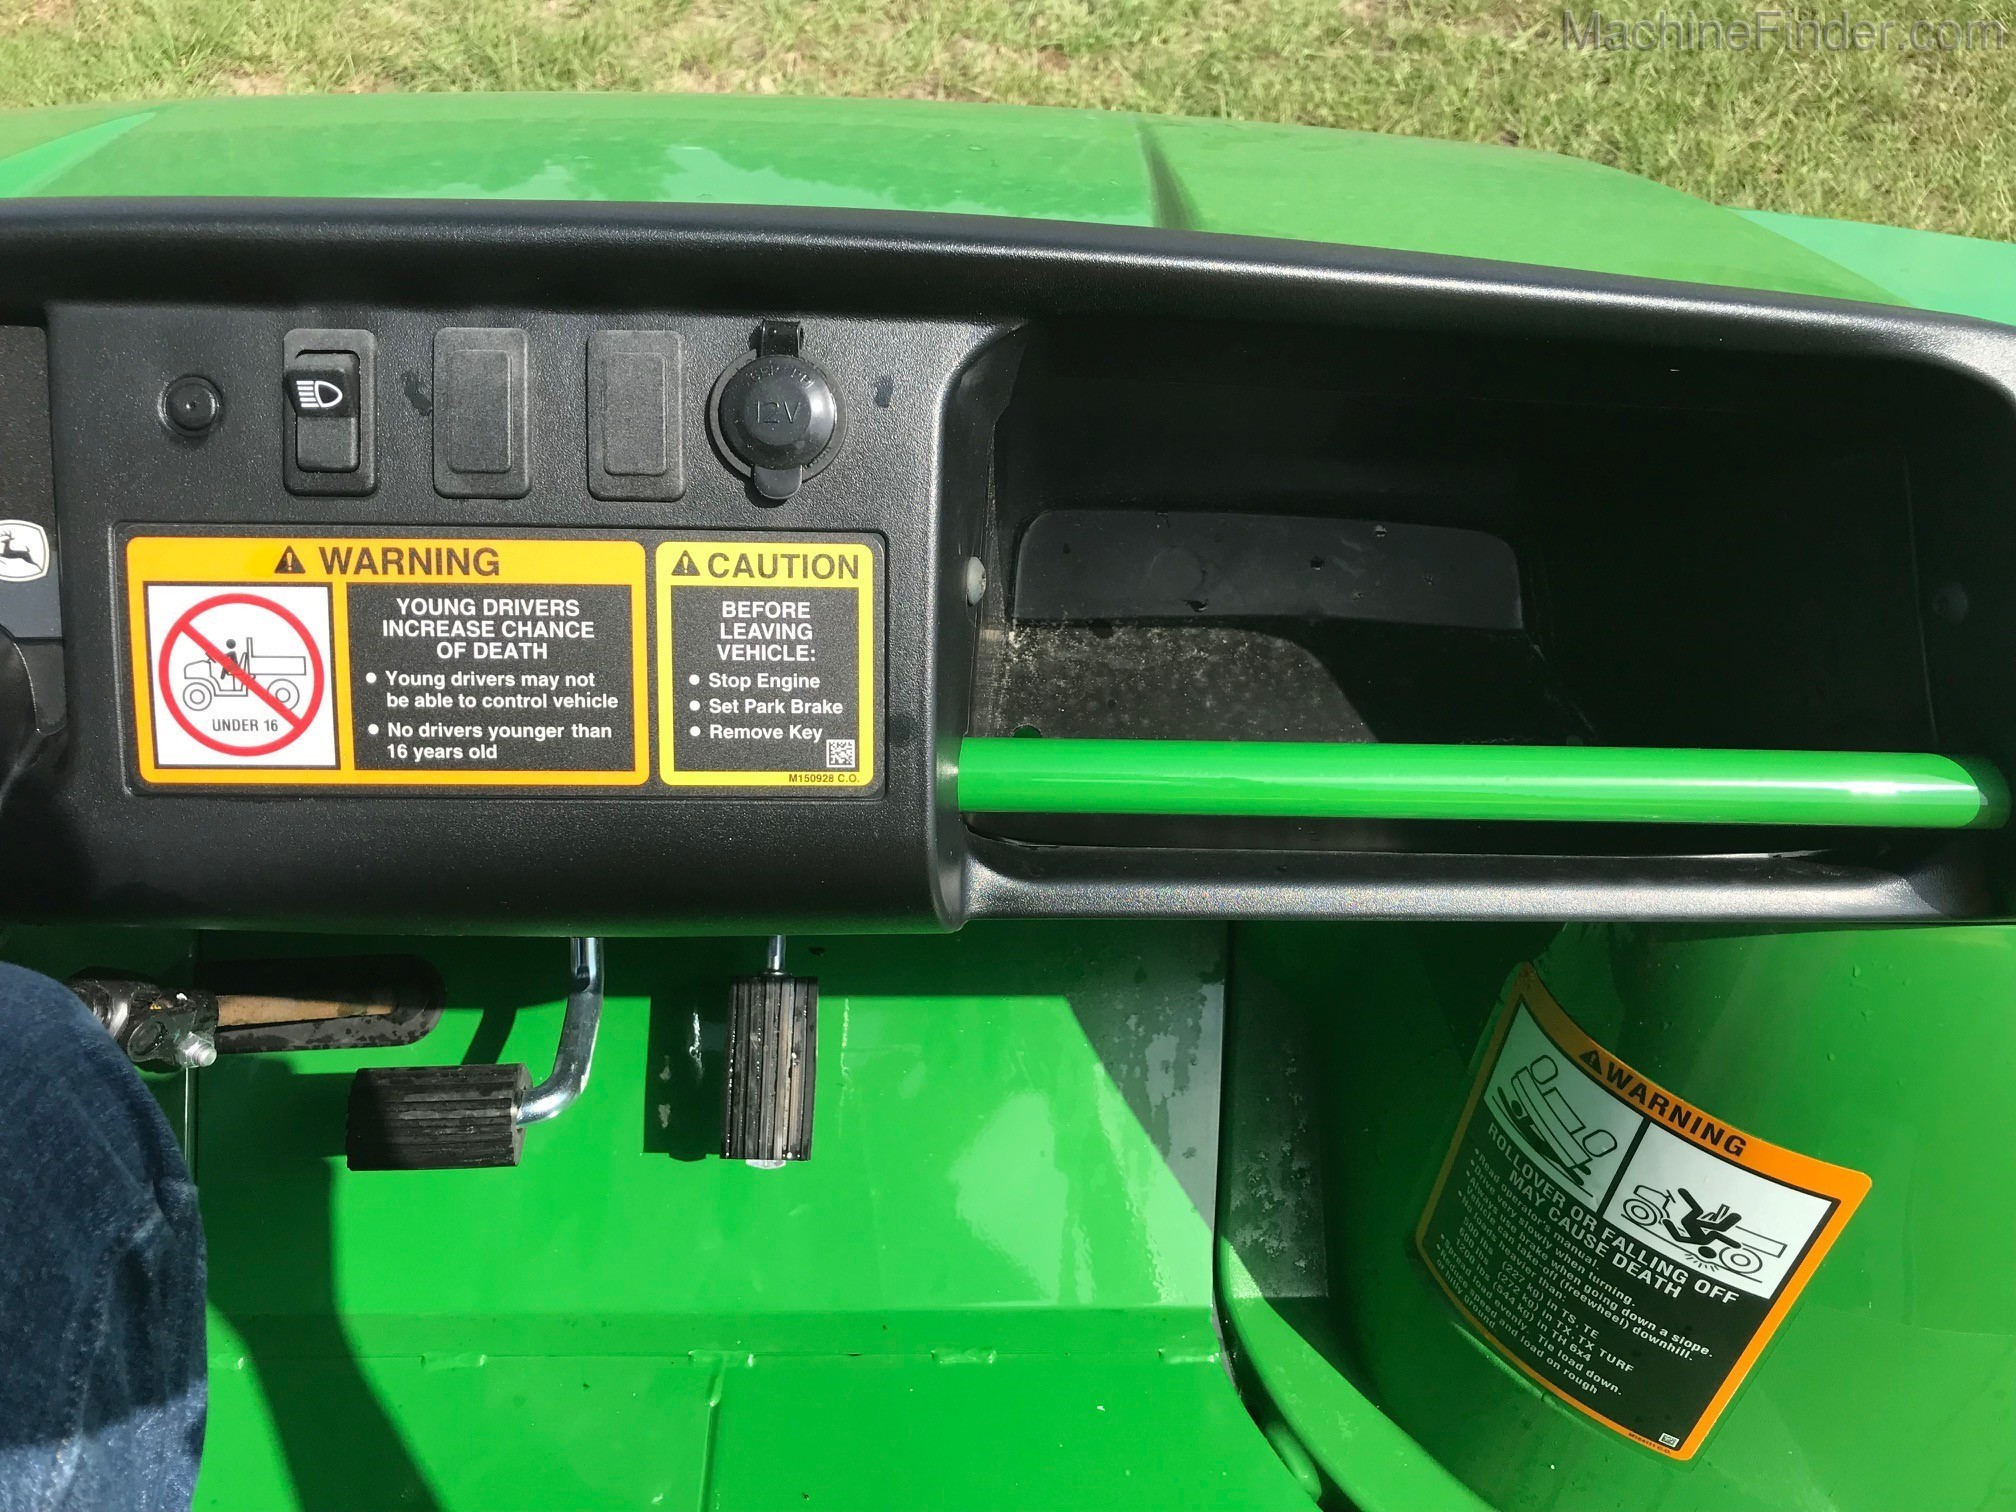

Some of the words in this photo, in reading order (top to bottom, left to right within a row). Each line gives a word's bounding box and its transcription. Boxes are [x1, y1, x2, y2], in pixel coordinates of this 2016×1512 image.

[755, 400, 801, 424] 12V
[318, 546, 499, 577] WARNING
[707, 552, 859, 580] CAUTION
[396, 597, 476, 616] YOUNG
[483, 598, 580, 617] DRIVERS
[721, 600, 811, 619] BEFORE
[382, 619, 495, 638] INCREASE
[501, 620, 595, 639] CHANCE
[720, 622, 813, 640] LEAVING
[436, 642, 467, 659] OF
[473, 642, 548, 660] DEATH
[716, 644, 816, 662] VEHICLE:
[385, 670, 446, 689] Young
[450, 671, 516, 687] drivers
[521, 675, 559, 690] may
[565, 672, 596, 687] not
[708, 672, 752, 691] Stop
[757, 672, 821, 692] Engine
[386, 692, 410, 708] be
[414, 692, 453, 708] able
[457, 694, 477, 708] to
[482, 693, 548, 709] control
[552, 692, 619, 708] vehicle
[708, 698, 739, 715] Set
[744, 698, 786, 715] Park
[791, 699, 844, 715] Brake
[212, 718, 259, 733] UNDER
[263, 718, 279, 733] 16
[387, 722, 414, 738] No
[418, 722, 483, 738] drivers
[488, 725, 565, 742] younger
[571, 723, 613, 739] than
[709, 724, 784, 740] Remove
[789, 724, 823, 743] Key
[386, 743, 408, 759] 16
[412, 747, 463, 763] years
[468, 744, 498, 759] old
[788, 773, 835, 783] M150928
[837, 773, 860, 783] C.O.
[1606, 1062, 1747, 1157] WARNING
[1479, 1154, 1500, 1184] Read
[1501, 1184, 1551, 1233] operator's
[1553, 1232, 1600, 1271] manual.
[1488, 1122, 1566, 1208] ROLLOVER
[1570, 1205, 1598, 1232] OR
[1601, 1227, 1689, 1285] FALLING
[1694, 1279, 1740, 1304] OFF
[1474, 1165, 1496, 1195] Drive
[1497, 1195, 1517, 1218] very
[1519, 1217, 1552, 1250] slowly
[1555, 1248, 1586, 1275] when
[1588, 1269, 1636, 1307] turning.
[1509, 1169, 1546, 1207] MAY
[1548, 1206, 1610, 1258] CAUSE
[1612, 1252, 1683, 1299] DEATH
[1462, 1197, 1472, 1213] No
[1473, 1212, 1497, 1242] loads
[1499, 1241, 1537, 1277] heavier
[1538, 1276, 1567, 1302] than:
[1467, 1185, 1496, 1225] Vehicle
[1497, 1225, 1516, 1245] can
[1516, 1243, 1559, 1281] take-off
[1559, 1278, 1630, 1329] (freewheel)
[1632, 1326, 1693, 1361] downhill.
[1470, 1177, 1498, 1215] Always
[1500, 1214, 1517, 1233] use
[1519, 1231, 1549, 1261] brake
[1551, 1260, 1582, 1286] when
[1583, 1283, 1618, 1312] going
[1621, 1308, 1657, 1331] down
[1659, 1328, 1669, 1337] a
[1671, 1333, 1713, 1358] slope.
[1480, 1236, 1494, 1255] lbs
[1502, 1261, 1526, 1283] (227
[1526, 1282, 1545, 1301] kg)
[1546, 1298, 1558, 1312] in
[1583, 1323, 1600, 1340] TE
[1475, 1247, 1489, 1266] lbs
[1497, 1271, 1521, 1295] (272
[1521, 1293, 1539, 1312] kg)
[1541, 1309, 1553, 1321] in
[1578, 1335, 1595, 1351] TX
[1599, 1348, 1635, 1372] TURF
[1476, 1264, 1491, 1282] lbs
[1492, 1281, 1516, 1305] (544
[1517, 1303, 1535, 1322] kg)
[1537, 1319, 1548, 1332] in
[1551, 1328, 1568, 1345] TH
[1569, 1343, 1592, 1362] 6x4
[1470, 1288, 1498, 1319] speed
[1499, 1318, 1519, 1338] and
[1520, 1335, 1545, 1358] load
[1546, 1357, 1561, 1371] on
[1563, 1368, 1599, 1394] rough
[1473, 1275, 1493, 1299] load
[1494, 1299, 1530, 1334] evenly.
[1538, 1333, 1555, 1352] Tie
[1557, 1349, 1584, 1372] load
[1585, 1369, 1622, 1396] down.
